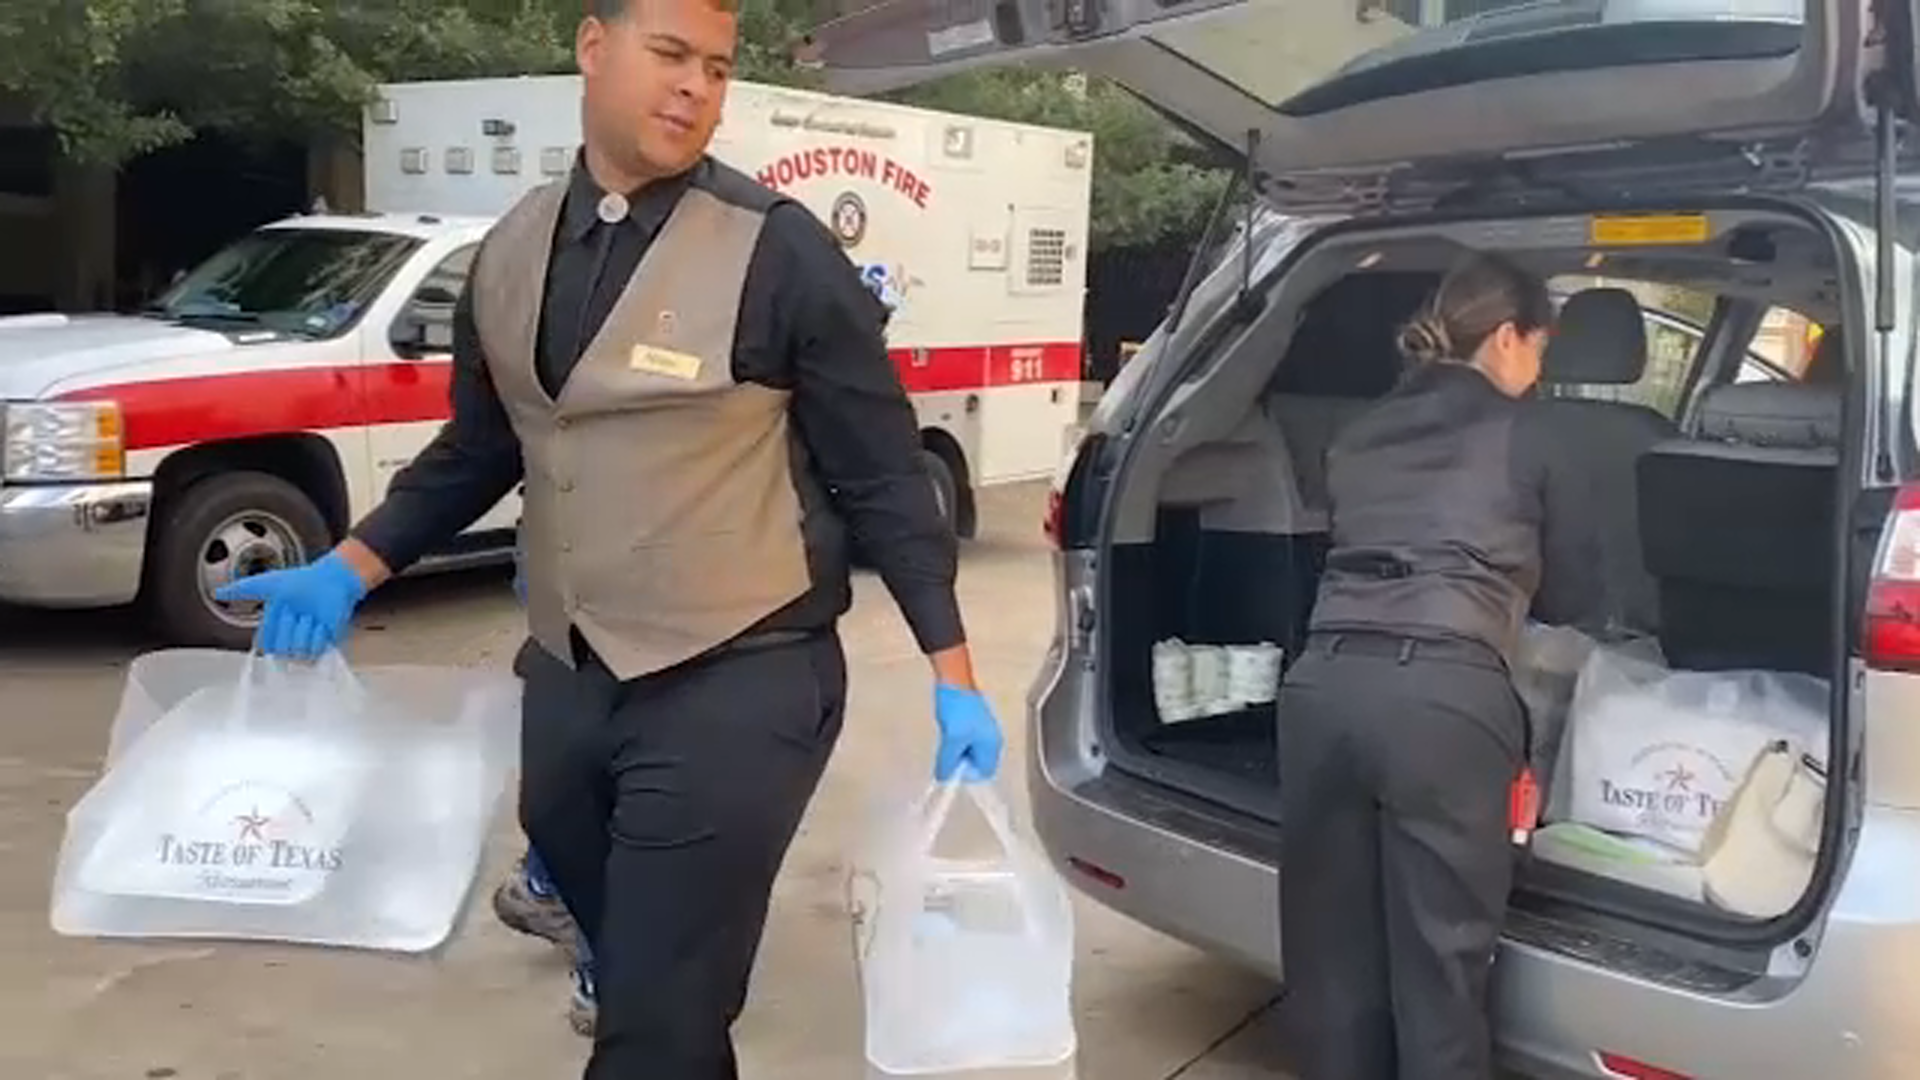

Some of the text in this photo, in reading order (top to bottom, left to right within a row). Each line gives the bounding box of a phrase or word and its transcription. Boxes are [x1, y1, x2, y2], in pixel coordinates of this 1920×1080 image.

[755, 147, 931, 209] HOUSTON FIRE
[1010, 358, 1043, 382] 911
[1601, 779, 1660, 811] TASTE
[1663, 793, 1690, 814] OF
[157, 833, 344, 871] TASTE OF TEXAS
